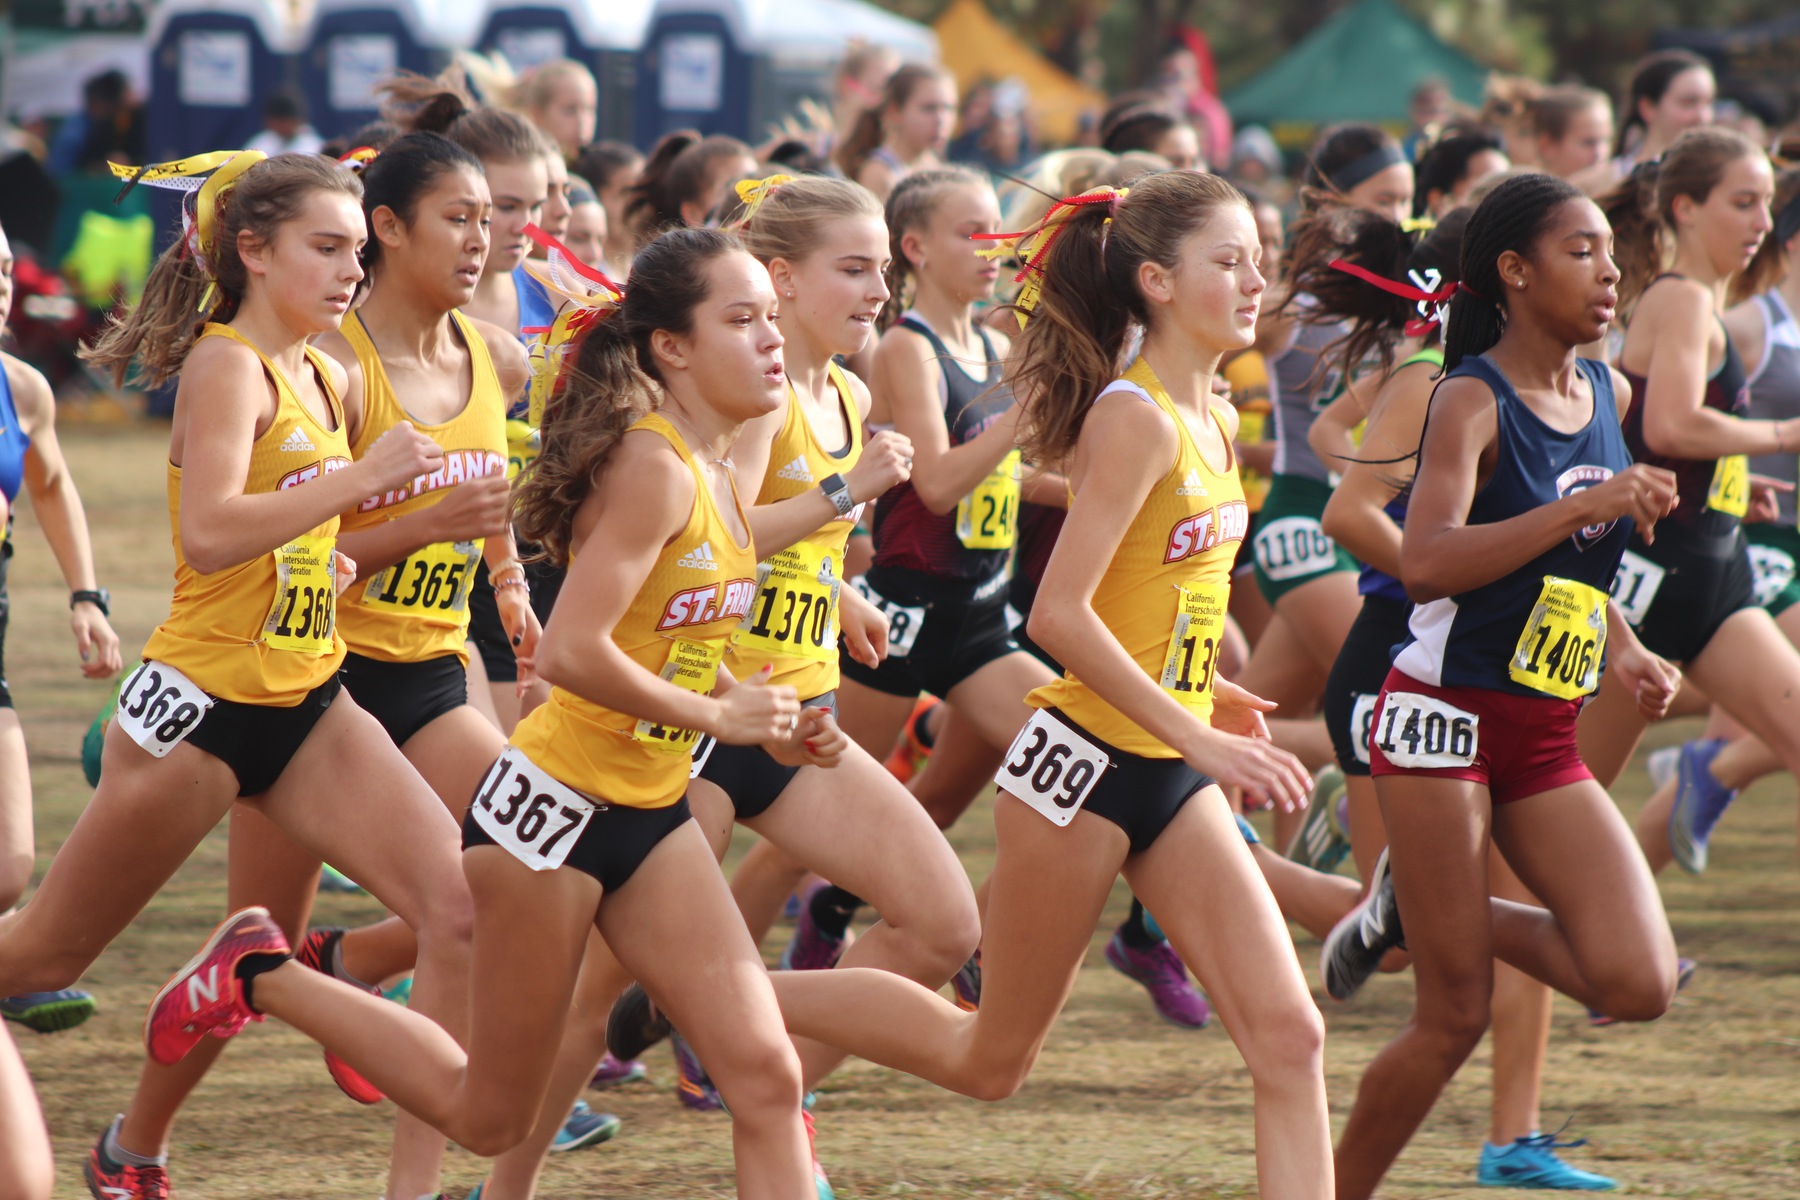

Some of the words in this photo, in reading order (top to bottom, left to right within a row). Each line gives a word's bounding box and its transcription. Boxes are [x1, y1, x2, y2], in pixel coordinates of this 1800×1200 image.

[280, 442, 316, 452] adidas
[777, 469, 815, 483] adidas
[1176, 487, 1208, 496] adidas
[981, 495, 1015, 537] 24
[1165, 510, 1215, 562] ST.
[281, 545, 310, 555] California
[282, 555, 320, 566] Interscholastic
[677, 559, 718, 571] adidas
[288, 566, 311, 576] deration
[770, 567, 798, 580] deration
[379, 559, 465, 609] 1365
[1186, 593, 1215, 604] California
[1549, 584, 1575, 600] California
[275, 585, 332, 640] 1368
[658, 585, 718, 631] ST.
[1547, 605, 1571, 620] deration
[750, 586, 828, 648] 1370
[1190, 614, 1214, 626] deration
[678, 642, 707, 658] California
[1525, 625, 1595, 688] 1406
[677, 666, 702, 679] deration
[120, 663, 199, 743] 1368
[1380, 706, 1473, 757] 1406
[479, 757, 584, 858] 1367
